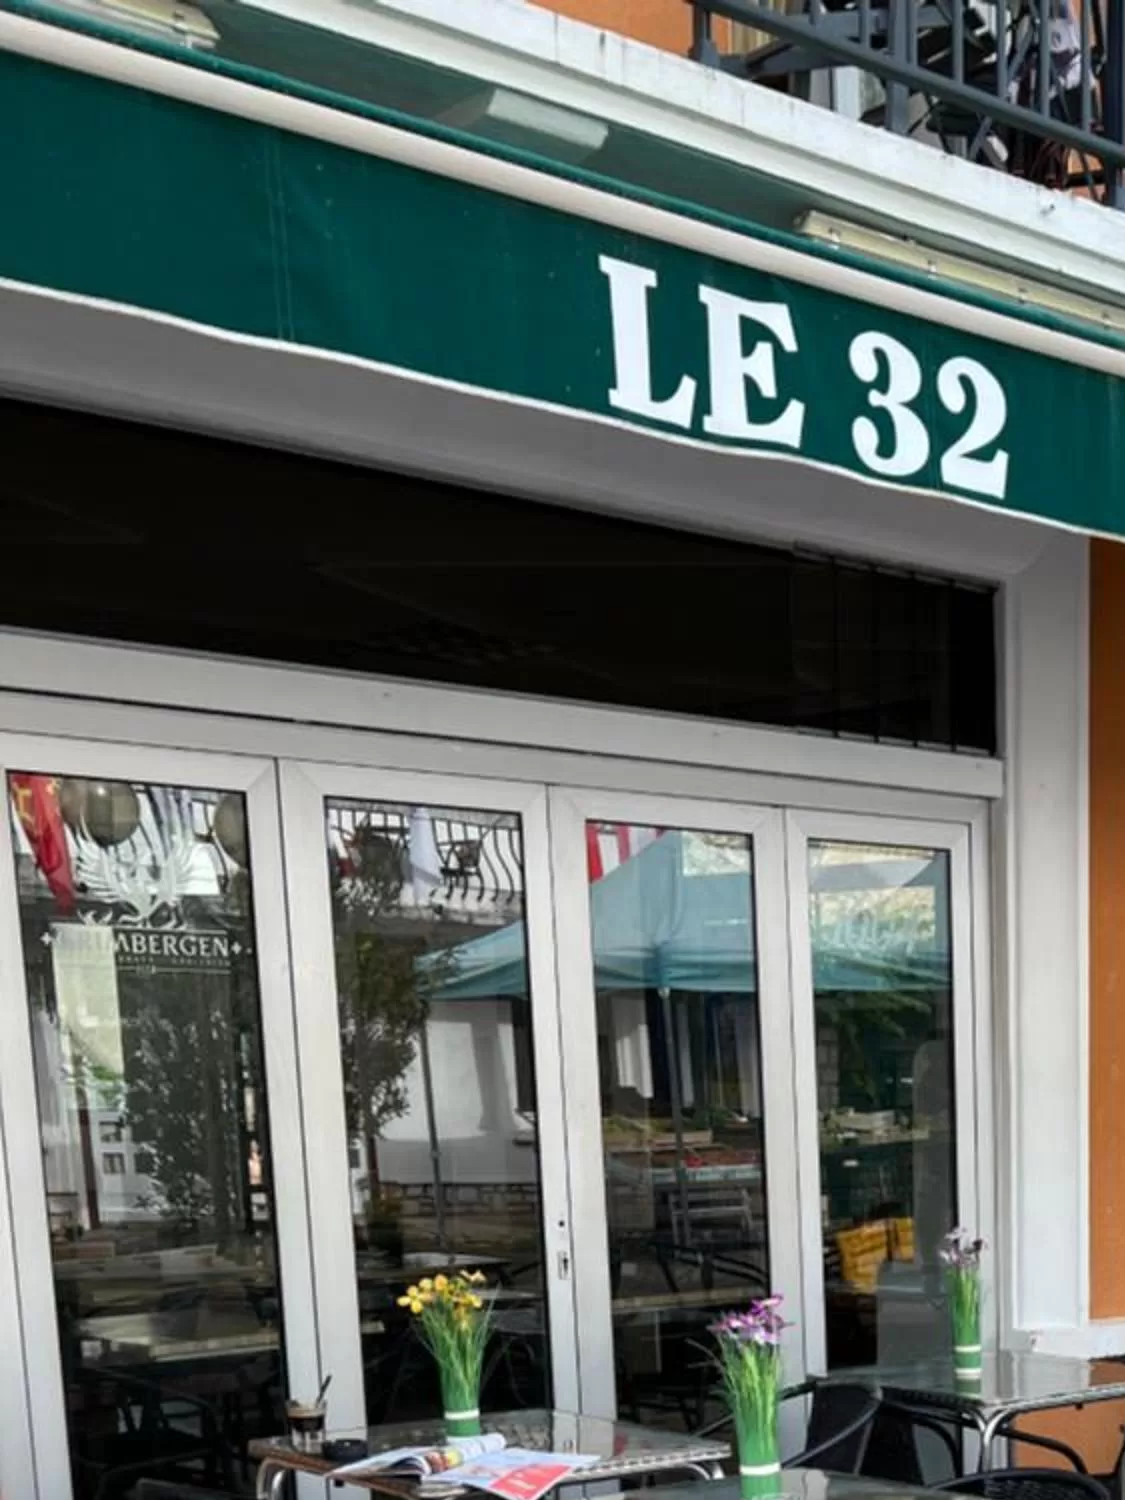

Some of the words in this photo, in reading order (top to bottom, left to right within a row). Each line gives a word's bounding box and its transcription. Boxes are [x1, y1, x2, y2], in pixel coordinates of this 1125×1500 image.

[599, 255, 804, 448] LE
[849, 331, 1008, 499] 32
[55, 928, 230, 957] MBERGEN
